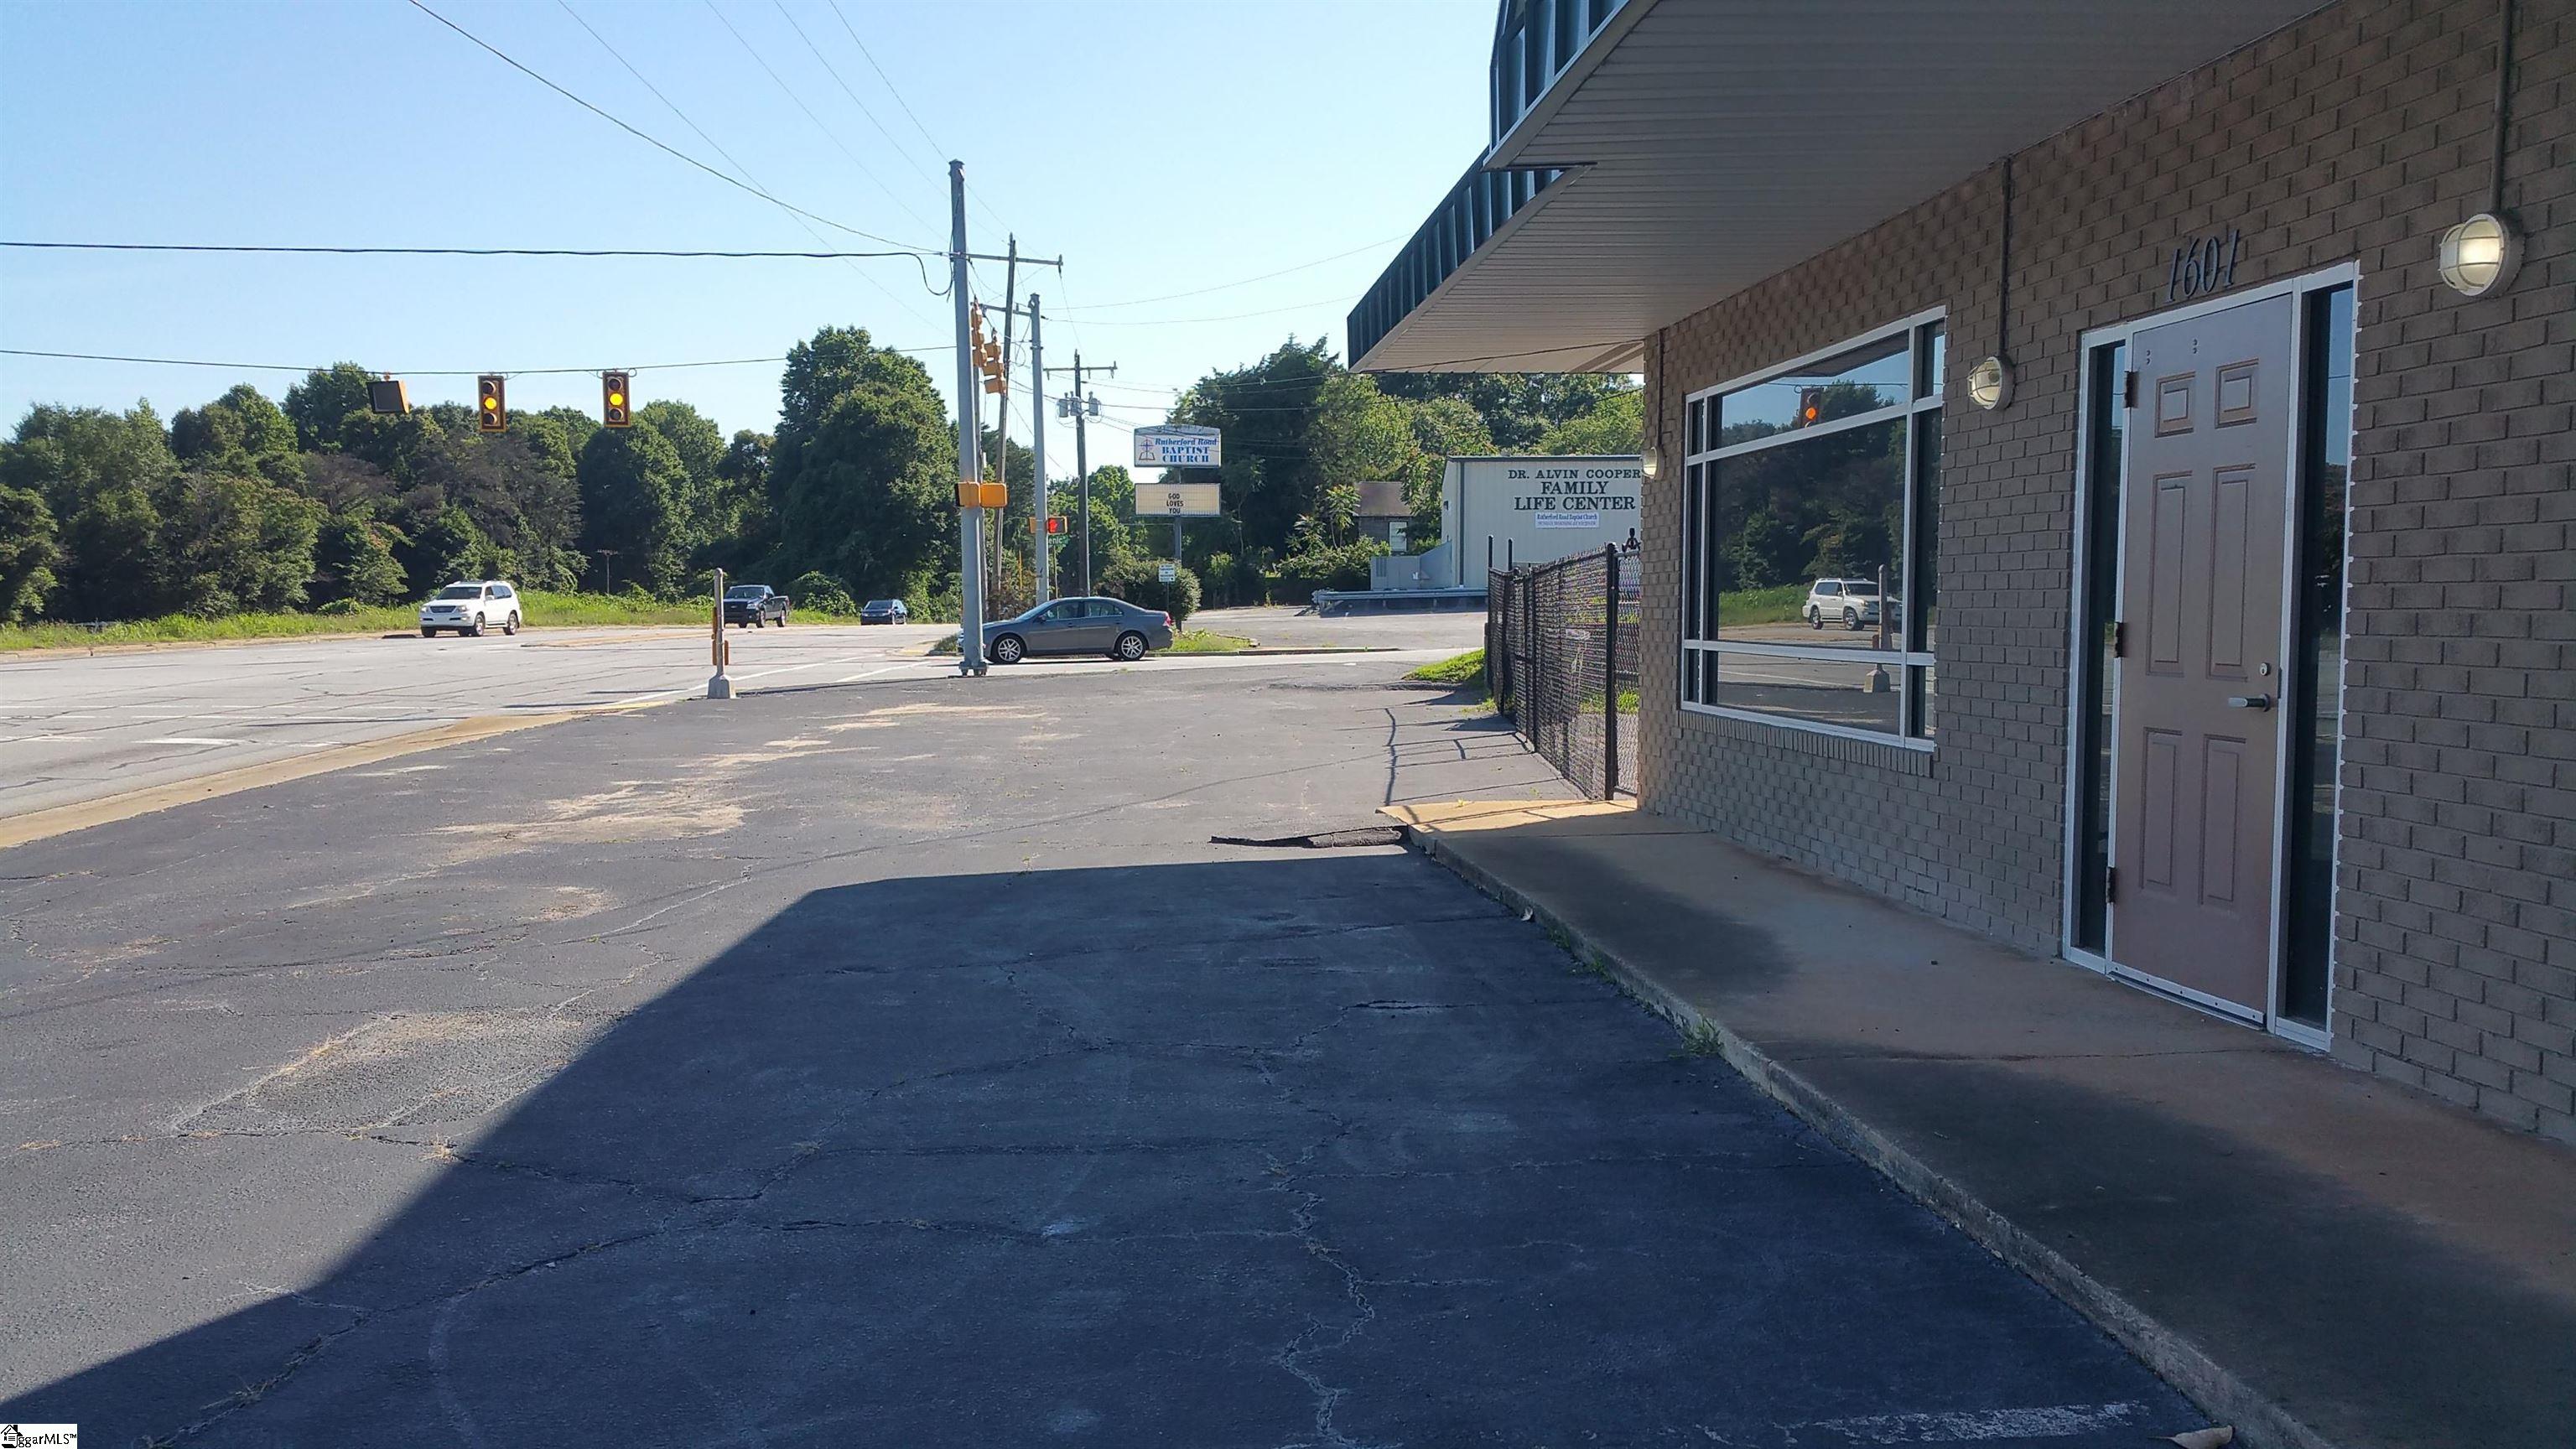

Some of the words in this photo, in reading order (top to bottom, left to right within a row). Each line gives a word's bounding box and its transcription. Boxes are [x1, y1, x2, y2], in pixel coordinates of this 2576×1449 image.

[2167, 229, 2240, 302] 1601
[1155, 438, 1196, 446] Rutherford
[1162, 454, 1208, 463] CHURCH
[1508, 470, 1530, 479] DR.
[1535, 469, 1579, 479] ALVIN
[1586, 469, 1641, 479] COOPER
[1540, 480, 1609, 495] FAMILY
[1514, 496, 1556, 511] LIFE
[1562, 496, 1636, 510] CENTER
